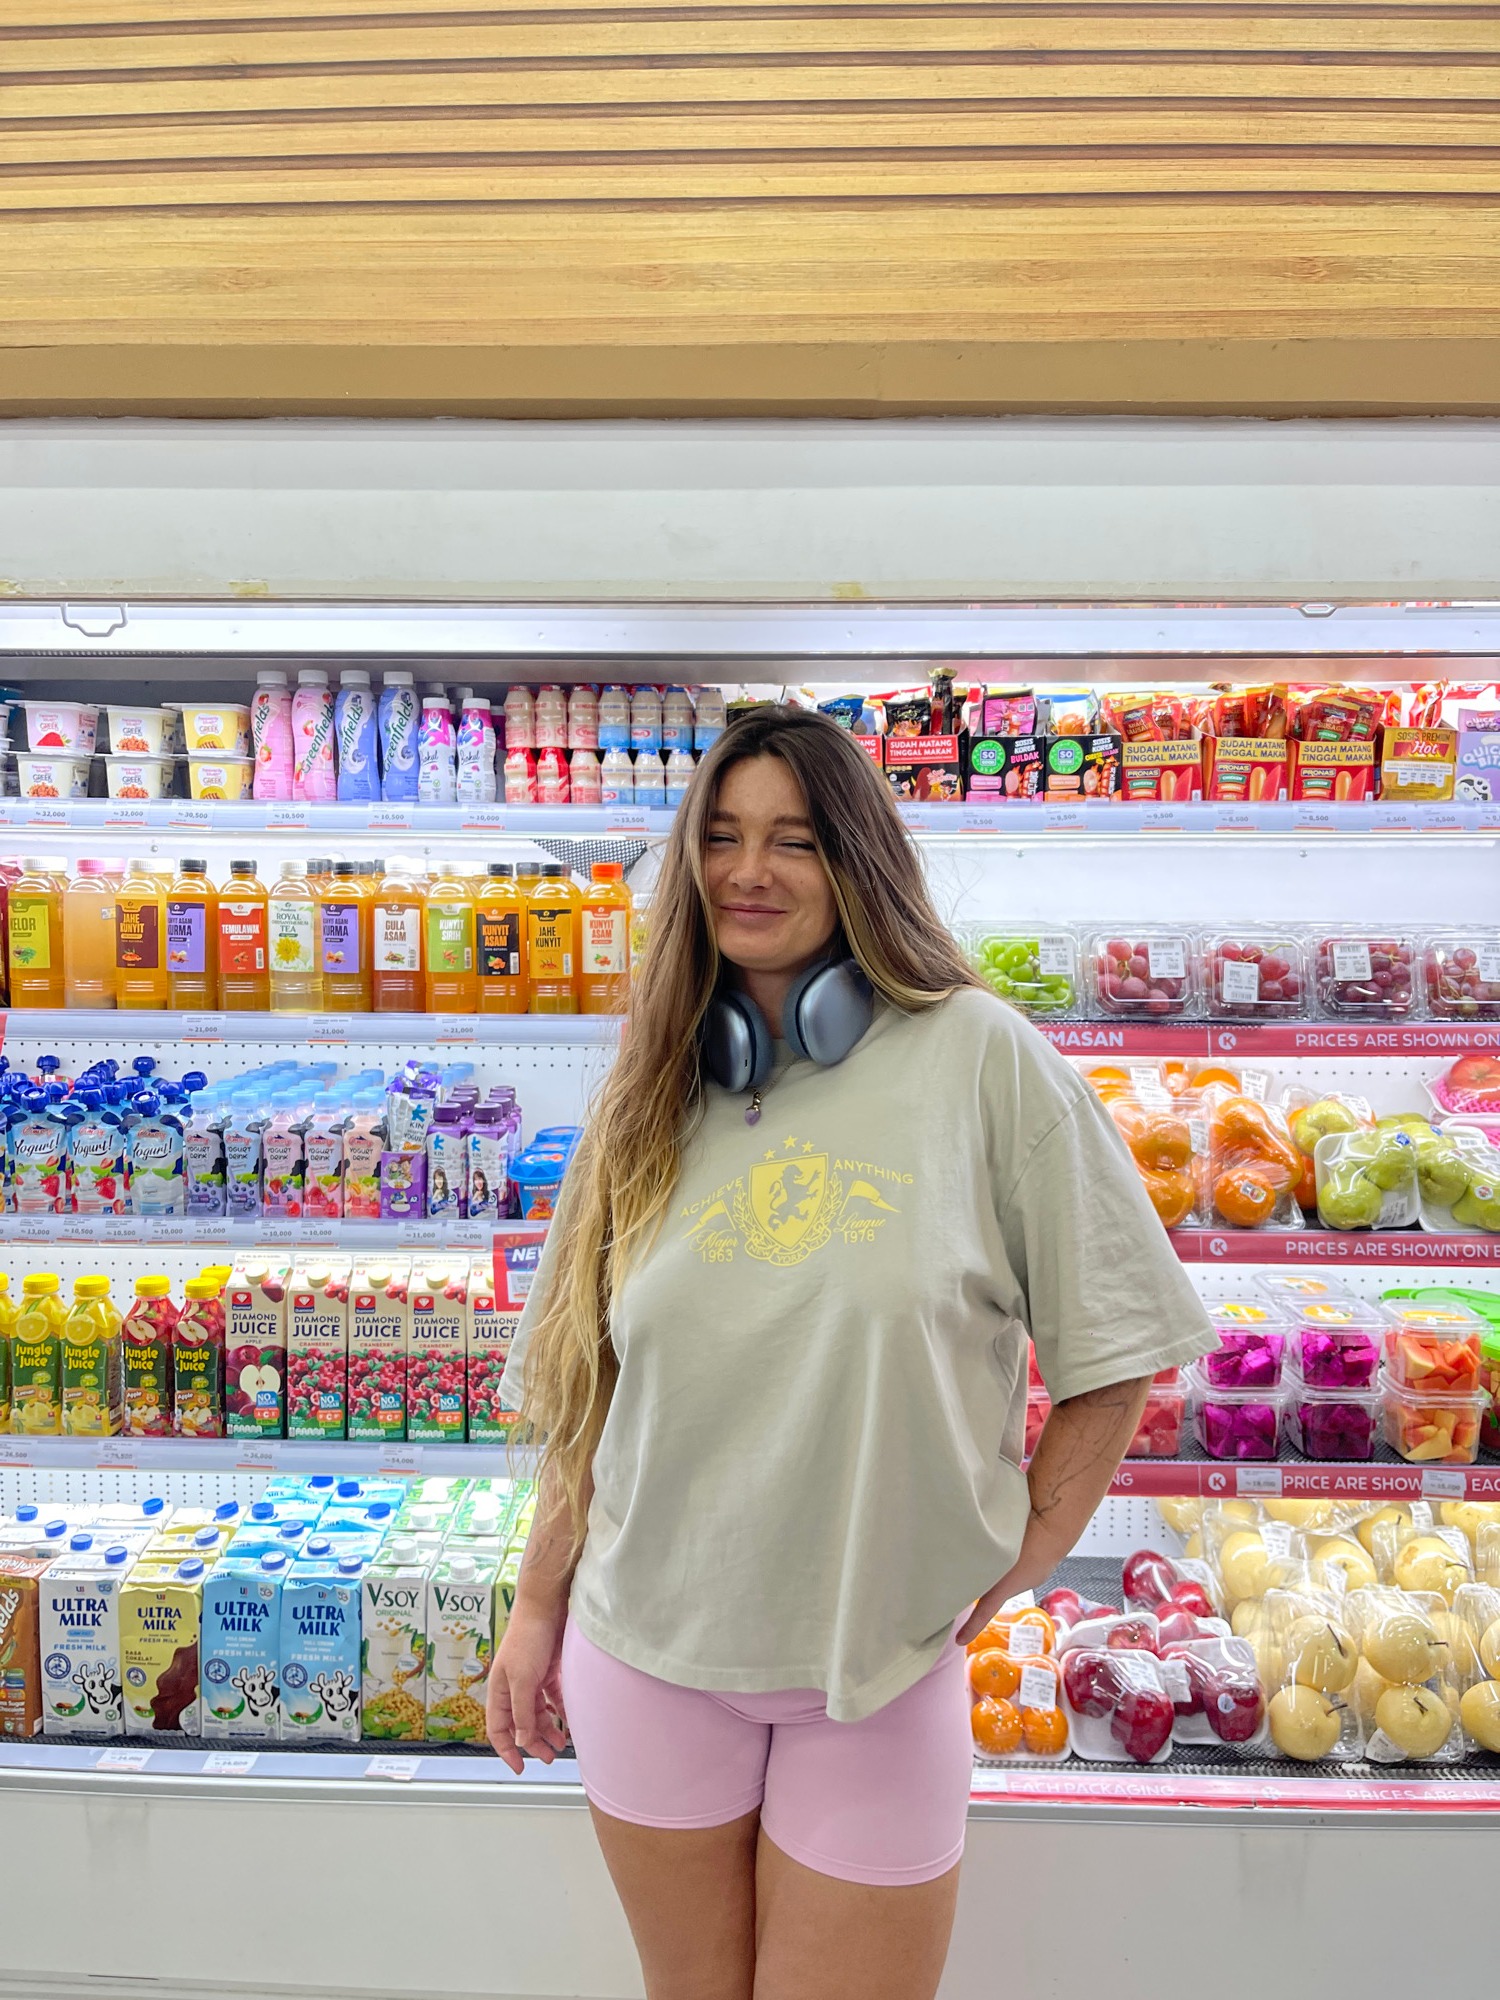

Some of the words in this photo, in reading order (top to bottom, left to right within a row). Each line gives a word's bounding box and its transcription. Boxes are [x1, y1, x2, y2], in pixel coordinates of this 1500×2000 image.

[123, 727, 142, 736] GREEK
[1397, 732, 1419, 741] SOSIS
[300, 702, 335, 774] Greenfields
[1127, 746, 1160, 754] SUDAH
[1162, 744, 1197, 752] MATANG
[1220, 740, 1252, 748] SUDAH
[1255, 741, 1285, 749] MATANG
[1304, 745, 1337, 753] SUDAH
[1339, 744, 1371, 753] MATANG
[1412, 740, 1437, 754] Hot
[890, 749, 922, 757] TINGGAL
[1010, 751, 1040, 764] BULDAK
[1060, 750, 1073, 759] SO
[1125, 755, 1166, 763] TINGGAL
[1168, 753, 1199, 761] MAKAN
[1218, 749, 1257, 757] TINGGAL
[1260, 750, 1286, 758] MAKAN
[1301, 754, 1343, 762] TINGGAL
[1345, 753, 1373, 761] MAKAN
[1127, 769, 1160, 777] PRONAS
[1217, 764, 1250, 772] PRONAS
[122, 776, 142, 785] GREEK
[123, 913, 140, 924] JAHE
[276, 912, 302, 921] ROYAL
[120, 923, 145, 933] KUNYIT
[221, 924, 260, 934] TEMULAWAK
[280, 925, 296, 933] TEA
[385, 920, 405, 931] GULA
[439, 919, 464, 931] KUNYIT
[482, 924, 510, 936] KUNYIT
[590, 919, 614, 929] KUNYIT
[384, 931, 407, 942] ASAM
[441, 930, 461, 941] SIRIH
[539, 926, 556, 937] JAHE
[592, 929, 612, 939] ASAM
[484, 936, 508, 947] ASAM
[535, 937, 561, 948] KUNYIT
[1295, 1033, 1358, 1047] PRICES
[1364, 1033, 1398, 1047] ARE
[1402, 1033, 1469, 1047] SHOWN
[409, 1122, 425, 1130] KIN
[15, 1133, 60, 1157] Yogurt!
[73, 1134, 113, 1158] Yogurt!
[680, 1176, 744, 1217] ACHIEVE
[833, 1159, 914, 1184] ANYTHING
[833, 1212, 886, 1233] League
[689, 1229, 738, 1252] Major
[844, 1229, 875, 1244] 1978
[702, 1248, 733, 1263] 1963
[748, 1245, 772, 1257] NEW
[776, 1251, 805, 1264] YORK
[1286, 1241, 1348, 1255] PRICES
[1353, 1242, 1387, 1256] ARE
[1391, 1242, 1458, 1257] SHOWN
[1463, 1244, 1488, 1258] ON
[355, 1316, 402, 1324] DIAMOND
[230, 1322, 277, 1335] JUICE
[293, 1324, 340, 1337] JUICE
[353, 1325, 401, 1337] JUICE
[412, 1326, 460, 1339] JUICE
[15, 1343, 53, 1357] Jungle
[65, 1345, 100, 1360] Jungle
[125, 1346, 158, 1360] Jungle
[176, 1348, 210, 1362] Jungle
[19, 1356, 48, 1368] Juice
[69, 1357, 96, 1370] Juice
[128, 1358, 154, 1371] Juice
[179, 1360, 206, 1373] Juice
[177, 1392, 193, 1400] Apple
[257, 1393, 271, 1401] NO
[320, 1395, 334, 1404] NO
[381, 1396, 395, 1405] NO
[440, 1397, 454, 1406] NO
[1283, 1475, 1330, 1490] PRICE
[1334, 1476, 1367, 1490] ARE
[1371, 1477, 1422, 1492] SHOW
[1471, 1477, 1500, 1492] EAC
[366, 1583, 419, 1608] V-SOY
[433, 1586, 486, 1613] V-SOY
[52, 1598, 108, 1612] ULTRA
[214, 1601, 270, 1618] ULTRA
[137, 1606, 182, 1619] ULTRA
[292, 1605, 346, 1623] ULTRA
[375, 1609, 413, 1617] ORIGINAL
[59, 1613, 102, 1626] MILK
[142, 1619, 177, 1631] MILK
[220, 1617, 262, 1632] MILK
[298, 1621, 340, 1636] MILK
[1010, 1781, 1060, 1794] EACH
[1064, 1782, 1175, 1797] PACKAGING
[1345, 1790, 1416, 1801] PRICES
